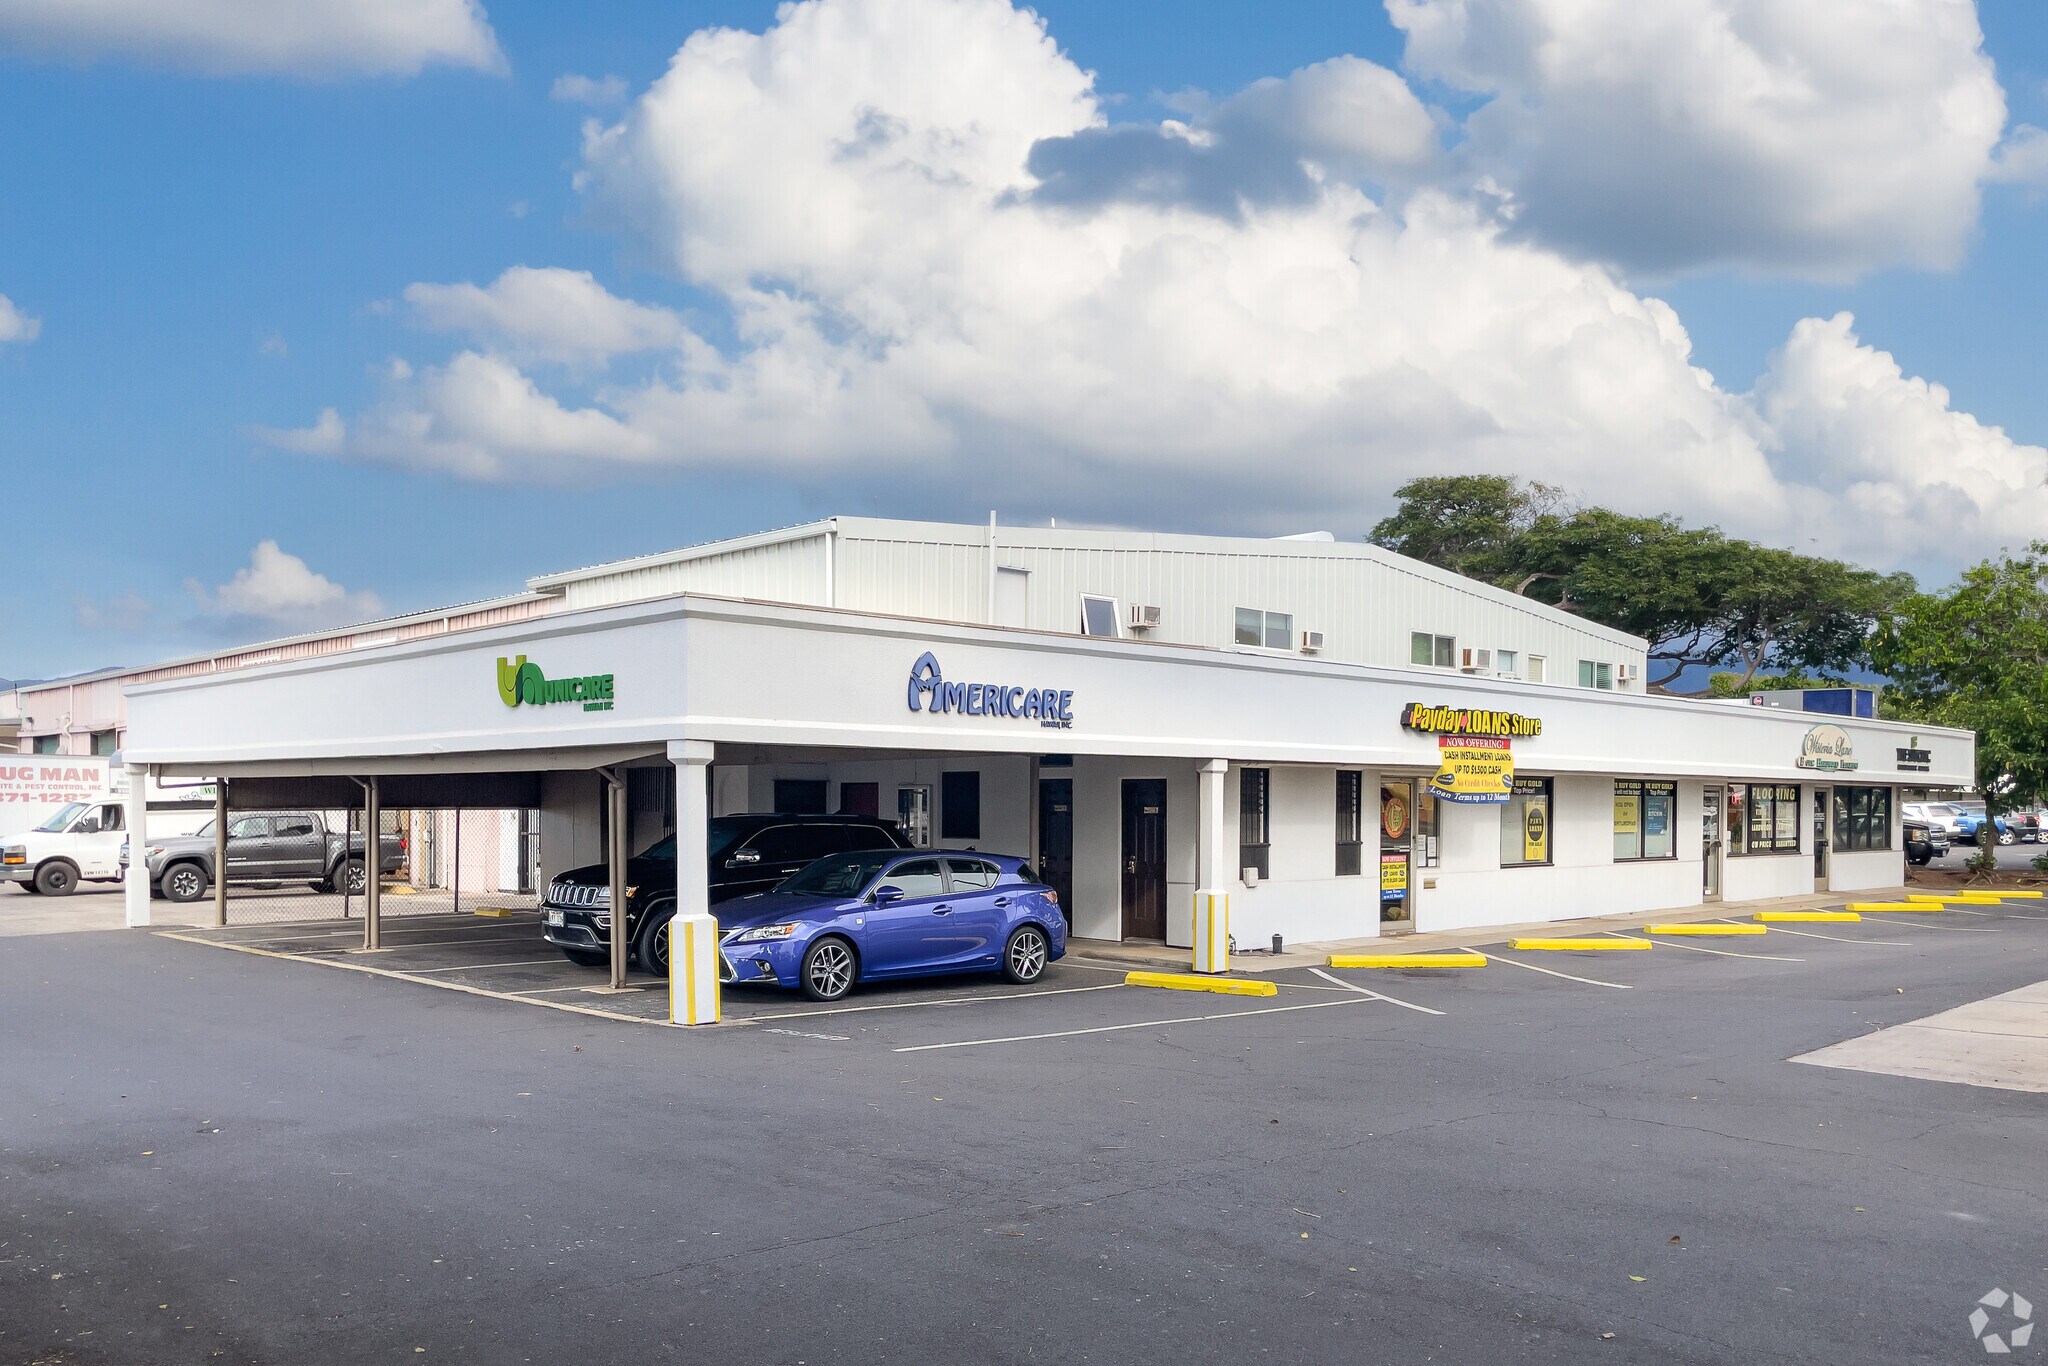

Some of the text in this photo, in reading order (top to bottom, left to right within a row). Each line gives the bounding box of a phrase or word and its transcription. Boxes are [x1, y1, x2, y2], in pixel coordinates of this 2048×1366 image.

[544, 674, 614, 703] UNICARE
[908, 651, 1074, 720] AMERICARE
[1411, 703, 1542, 736] Payday LOANS Store
[1446, 738, 1504, 748] NOW OFFERING!
[1444, 750, 1511, 761] CASH INSTALLMENT LOANS
[40, 767, 100, 782] MAN
[1454, 765, 1462, 774] UP
[1463, 765, 1470, 774] TO
[1488, 766, 1502, 775] CASH
[1429, 786, 1452, 799] Loan
[1454, 791, 1472, 801] Terms
[1473, 794, 1480, 802] up
[1480, 793, 1486, 801] to
[1487, 792, 1494, 801] 12
[1751, 787, 1796, 800] FLOORING
